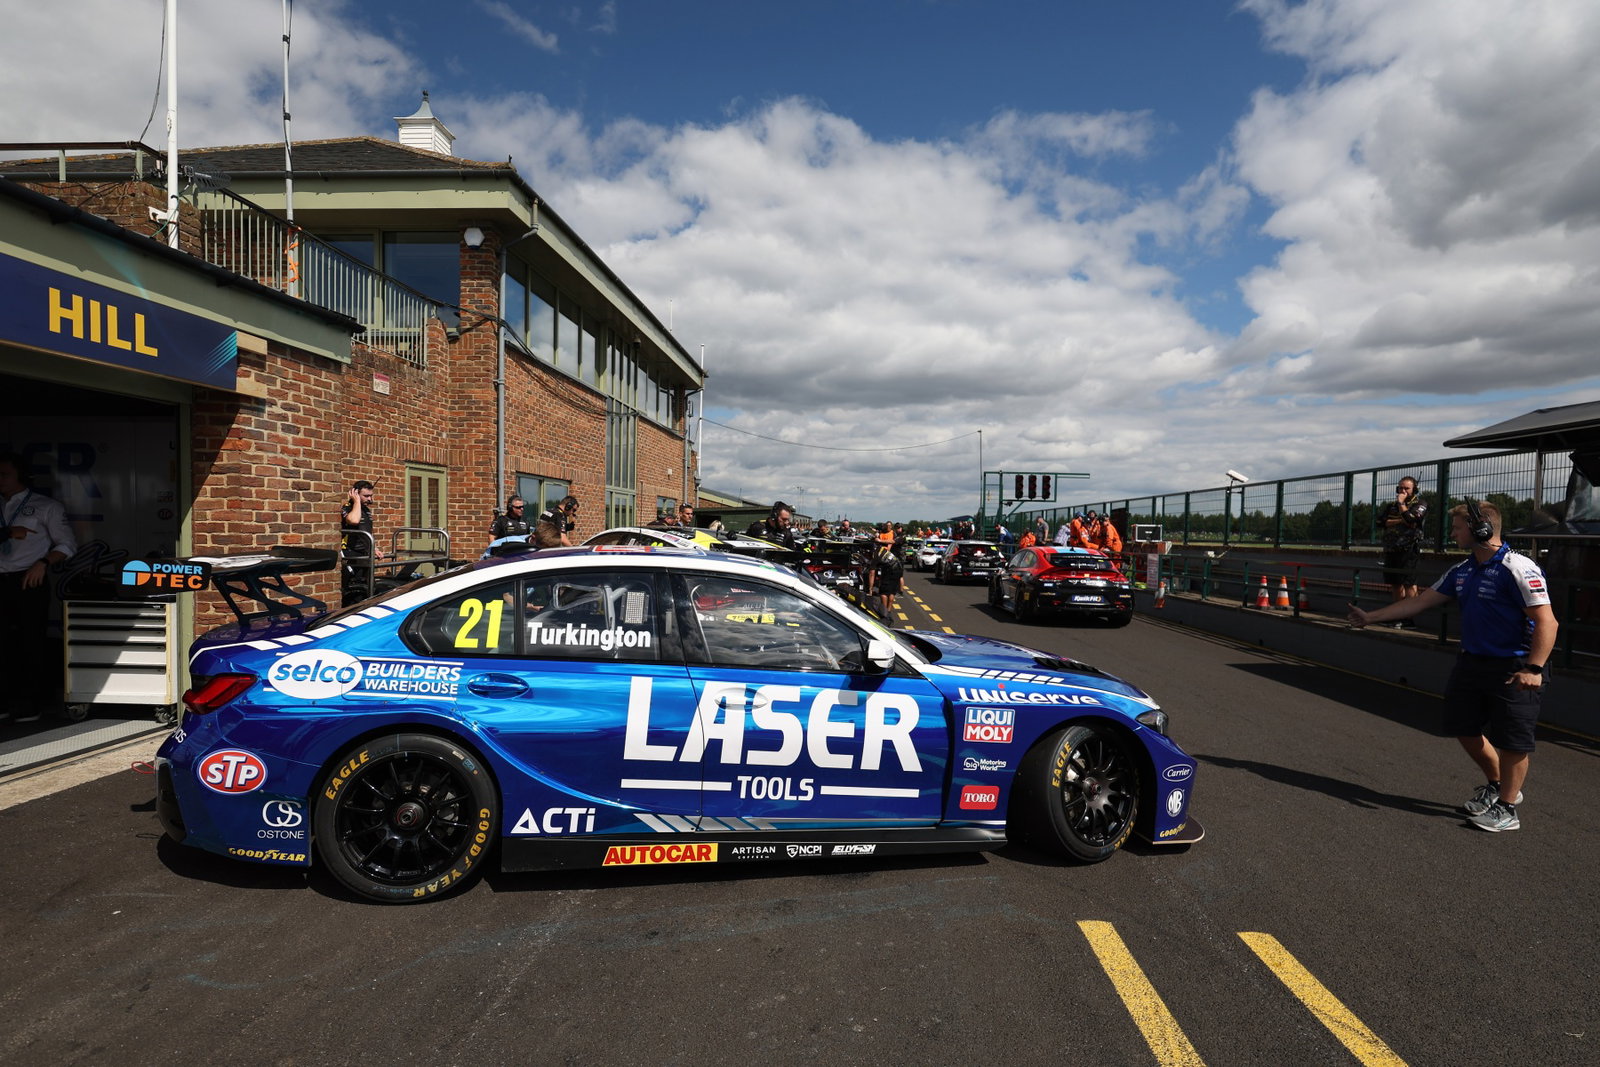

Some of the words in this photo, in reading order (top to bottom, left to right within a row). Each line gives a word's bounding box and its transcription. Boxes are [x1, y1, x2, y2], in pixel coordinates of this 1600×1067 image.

[48, 287, 158, 357] HILL
[152, 562, 203, 576] POWER
[152, 574, 203, 590] TEC
[453, 598, 504, 650] 21
[527, 621, 651, 651] Turkington
[273, 659, 357, 684] selco
[365, 662, 462, 682] BUILDERS
[364, 678, 459, 696] WAREHOUSE
[622, 676, 924, 773] LASER
[968, 708, 1013, 726] LIQUI
[965, 725, 1012, 742] MOLY
[206, 755, 260, 789] STP
[980, 759, 1007, 767] Motoring
[1051, 741, 1072, 788] EAGLE
[325, 749, 371, 801] EAGLE
[1166, 768, 1190, 778] Carrier
[736, 775, 815, 802] TOOLS
[257, 830, 305, 840] OSTONE
[228, 848, 306, 862] GOODYEAR
[604, 844, 712, 865] AUTOCAR
[731, 846, 776, 854] ARTISAN
[798, 845, 822, 854] NCPI
[831, 844, 876, 853] JELLYFISH
